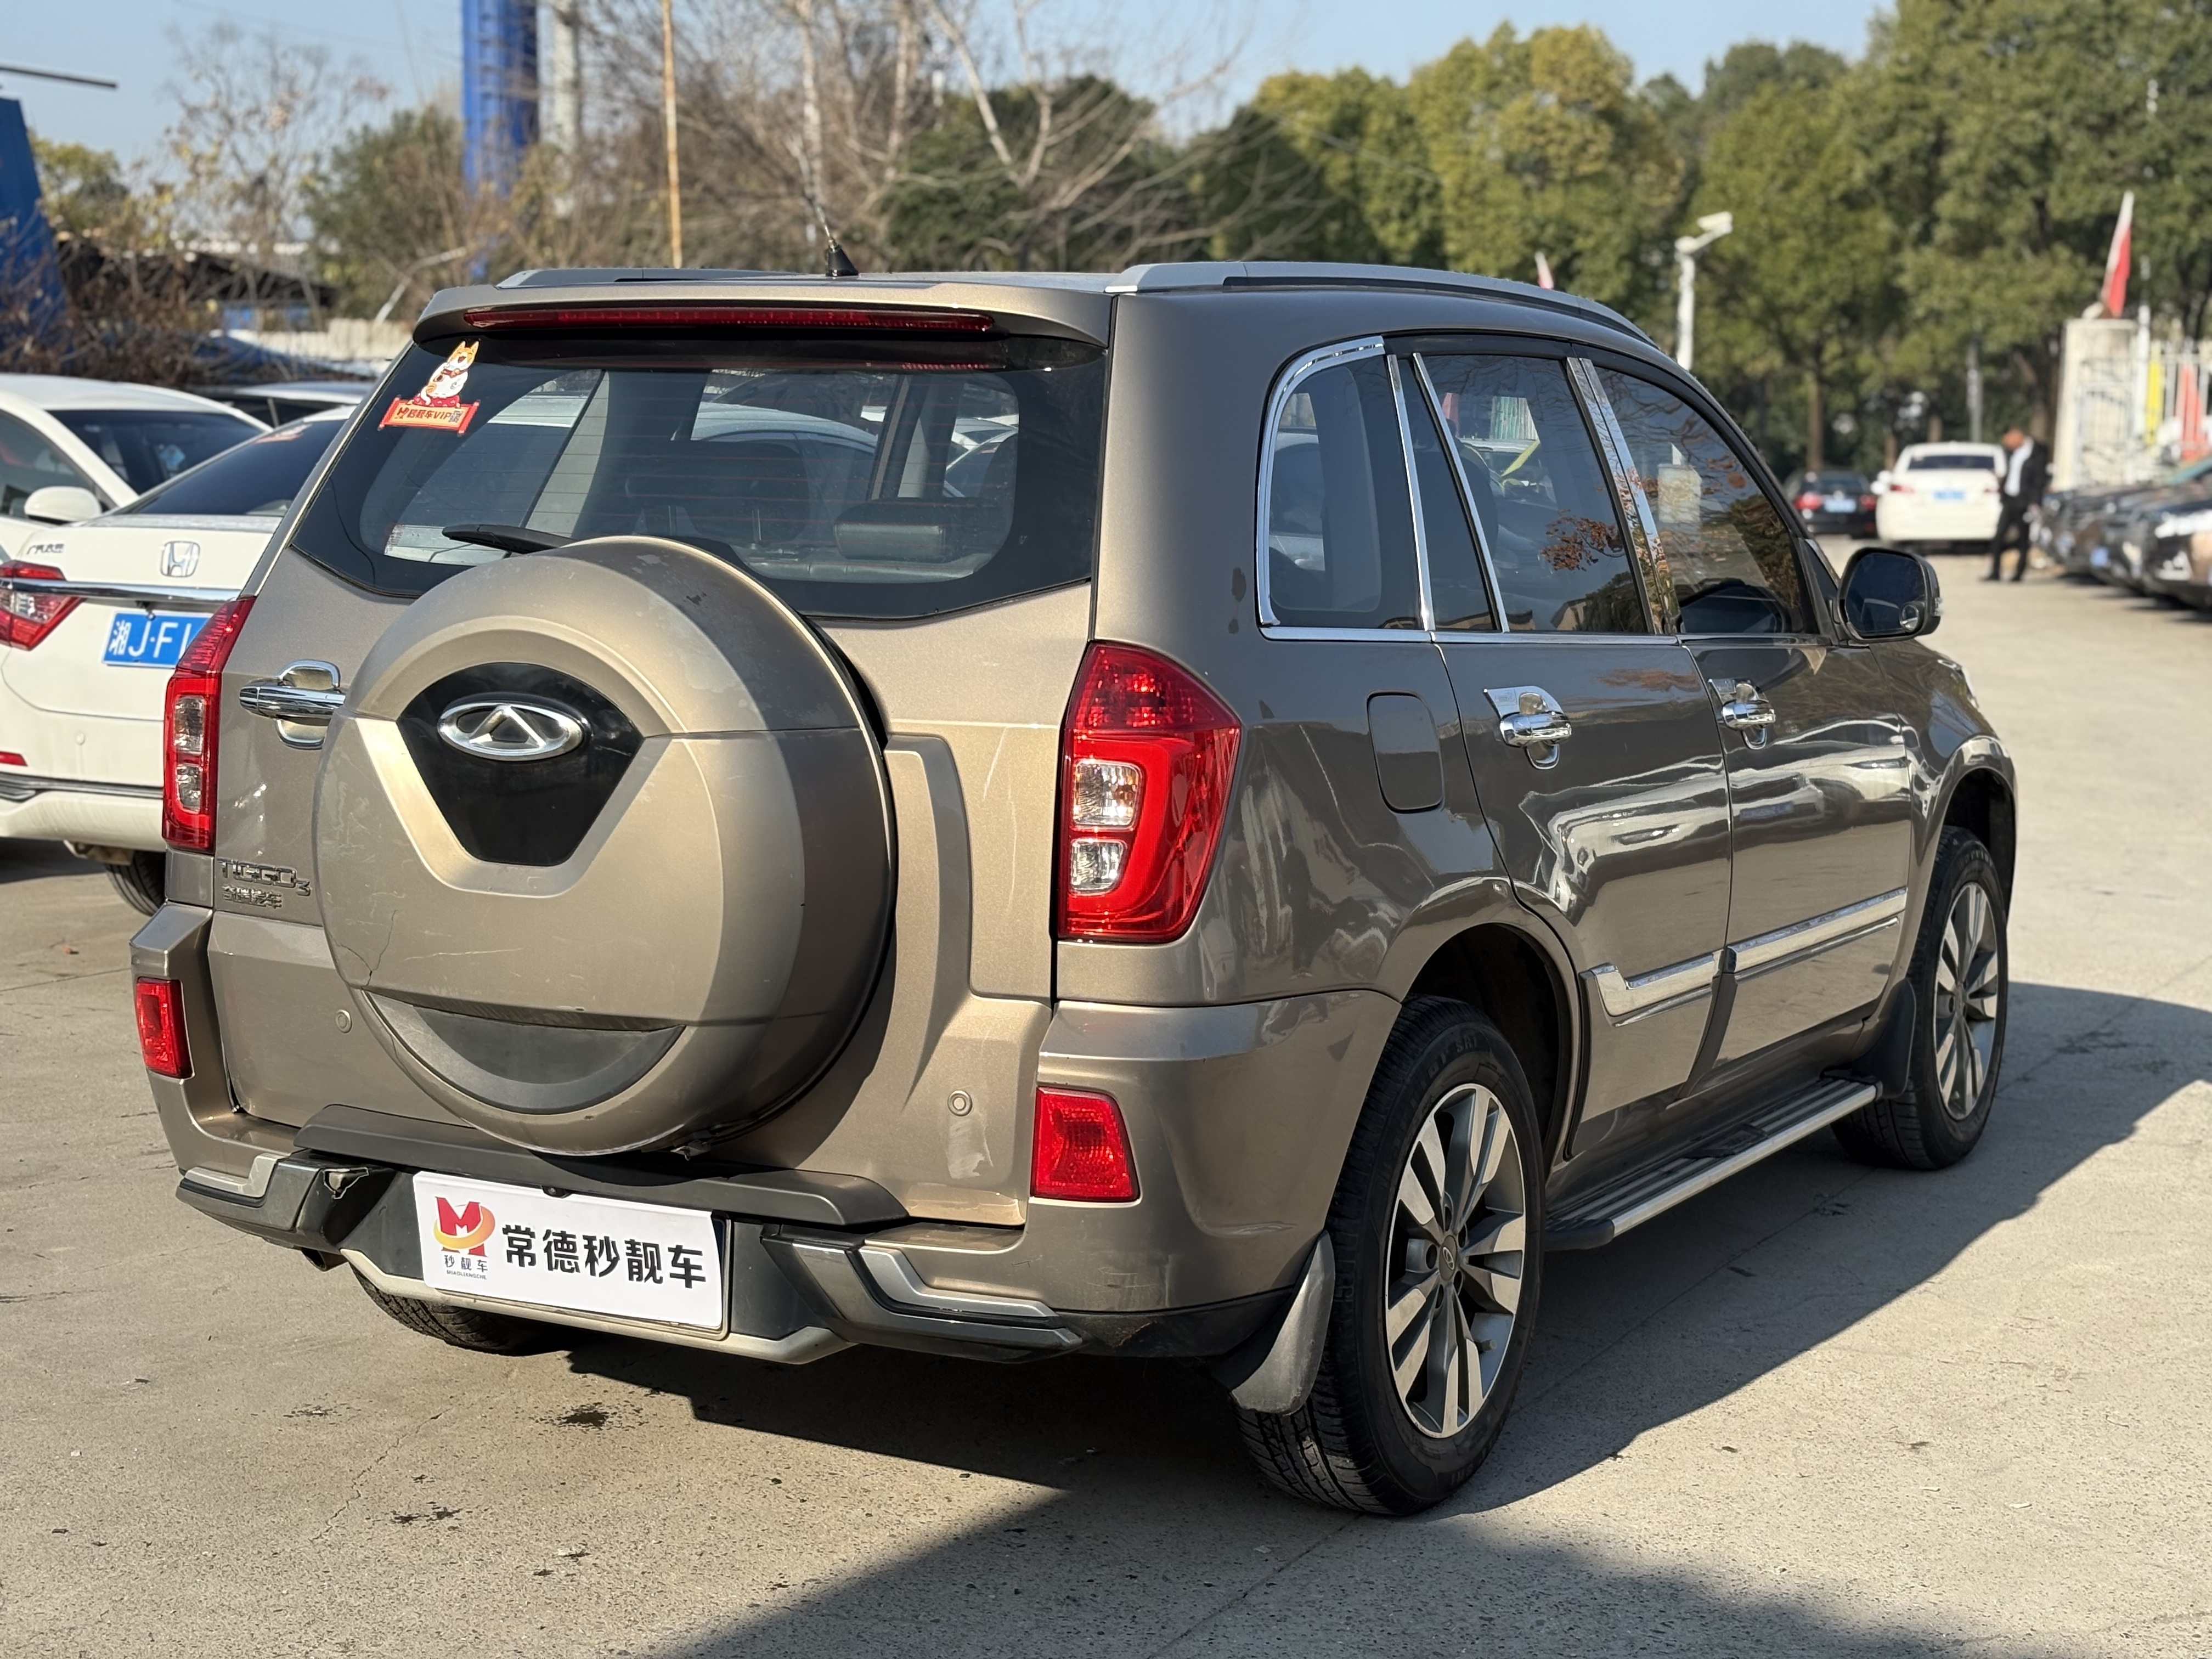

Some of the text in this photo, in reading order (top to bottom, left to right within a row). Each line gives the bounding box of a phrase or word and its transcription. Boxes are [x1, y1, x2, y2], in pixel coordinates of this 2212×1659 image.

[444, 1255, 488, 1273] 秒靓车
[501, 1223, 706, 1289] 常德秒靓车
